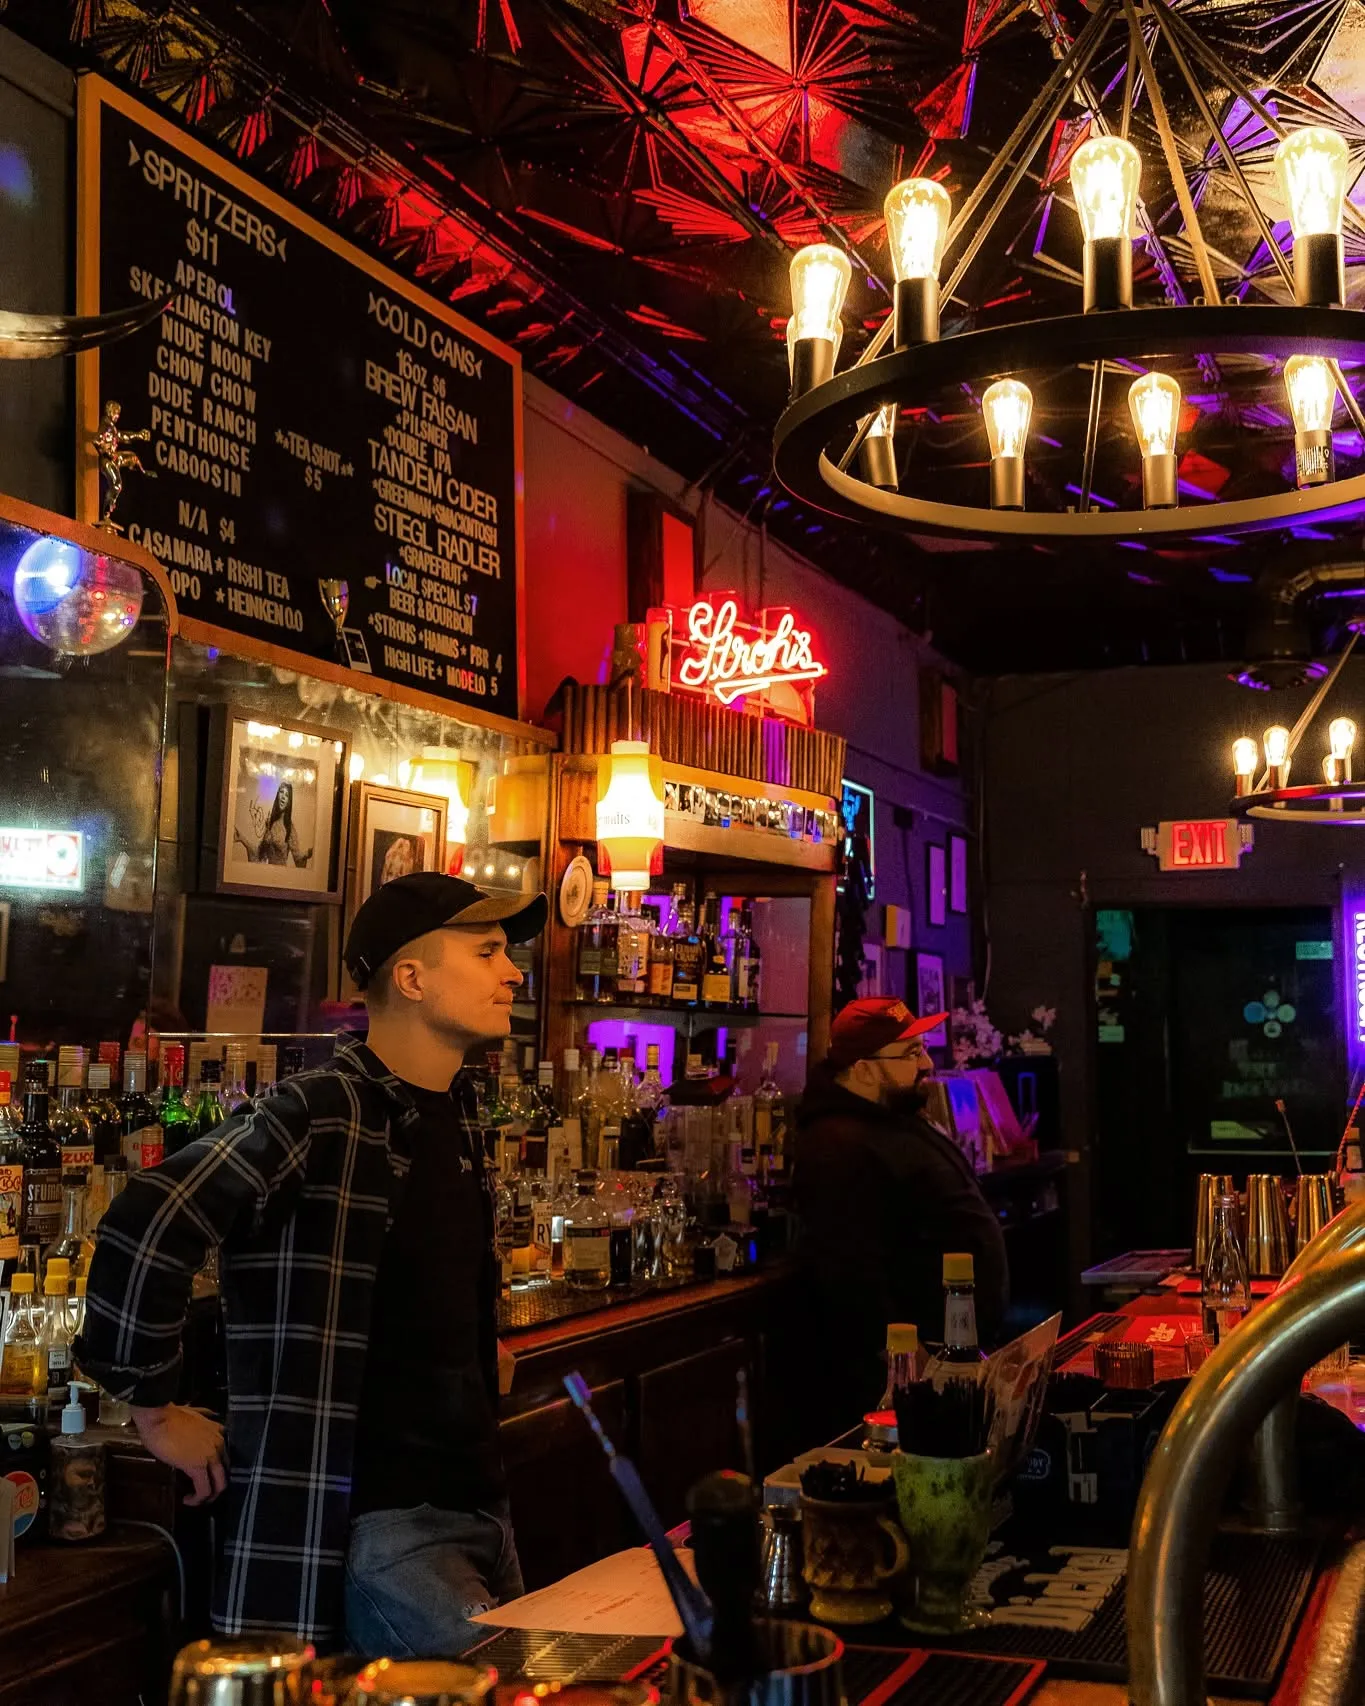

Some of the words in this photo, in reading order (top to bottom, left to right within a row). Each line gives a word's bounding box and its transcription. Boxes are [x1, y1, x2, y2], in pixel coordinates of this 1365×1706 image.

[143, 150, 277, 257] SPRITZERS
[186, 218, 218, 266] $11
[175, 259, 236, 315] APEROL
[162, 313, 204, 358] NUDE
[211, 340, 251, 383] NOON
[244, 328, 271, 363] KEY
[376, 297, 427, 348] COLD
[431, 331, 475, 377] CANS
[157, 345, 204, 389] CHOW
[211, 372, 256, 414] CHOW
[366, 360, 417, 411] BREW
[422, 391, 478, 444] FAISAN
[149, 372, 192, 415] DUDE
[203, 398, 256, 445] RANCH
[402, 409, 448, 450] PILSNER
[152, 405, 250, 472] PENTHOUSE
[388, 425, 427, 463] DOUBLE
[434, 448, 452, 475] IPA
[156, 440, 241, 497] CABOOSIN
[305, 466, 322, 491] $5
[368, 438, 441, 499] TANDEM
[446, 478, 497, 524] CIDER
[179, 500, 208, 535] N/A
[220, 517, 235, 544] $4
[374, 503, 433, 552] STEGL
[438, 528, 500, 579] RADLER
[228, 557, 262, 591] RISHI
[265, 570, 290, 600] TEA
[386, 562, 420, 595] LOCAL
[421, 578, 463, 611] SPECIAL
[404, 546, 463, 585] GRAPEFRUIT
[389, 588, 415, 616] BEER
[425, 601, 473, 637] BOURBON
[374, 612, 417, 645] STROHS
[470, 644, 489, 670] PBR
[680, 600, 822, 692] Stroh's
[384, 645, 411, 673] HIGH
[411, 653, 436, 681] LIFE
[446, 664, 486, 695] MODELO
[490, 676, 498, 696] 5
[1173, 823, 1227, 865] EXIT
